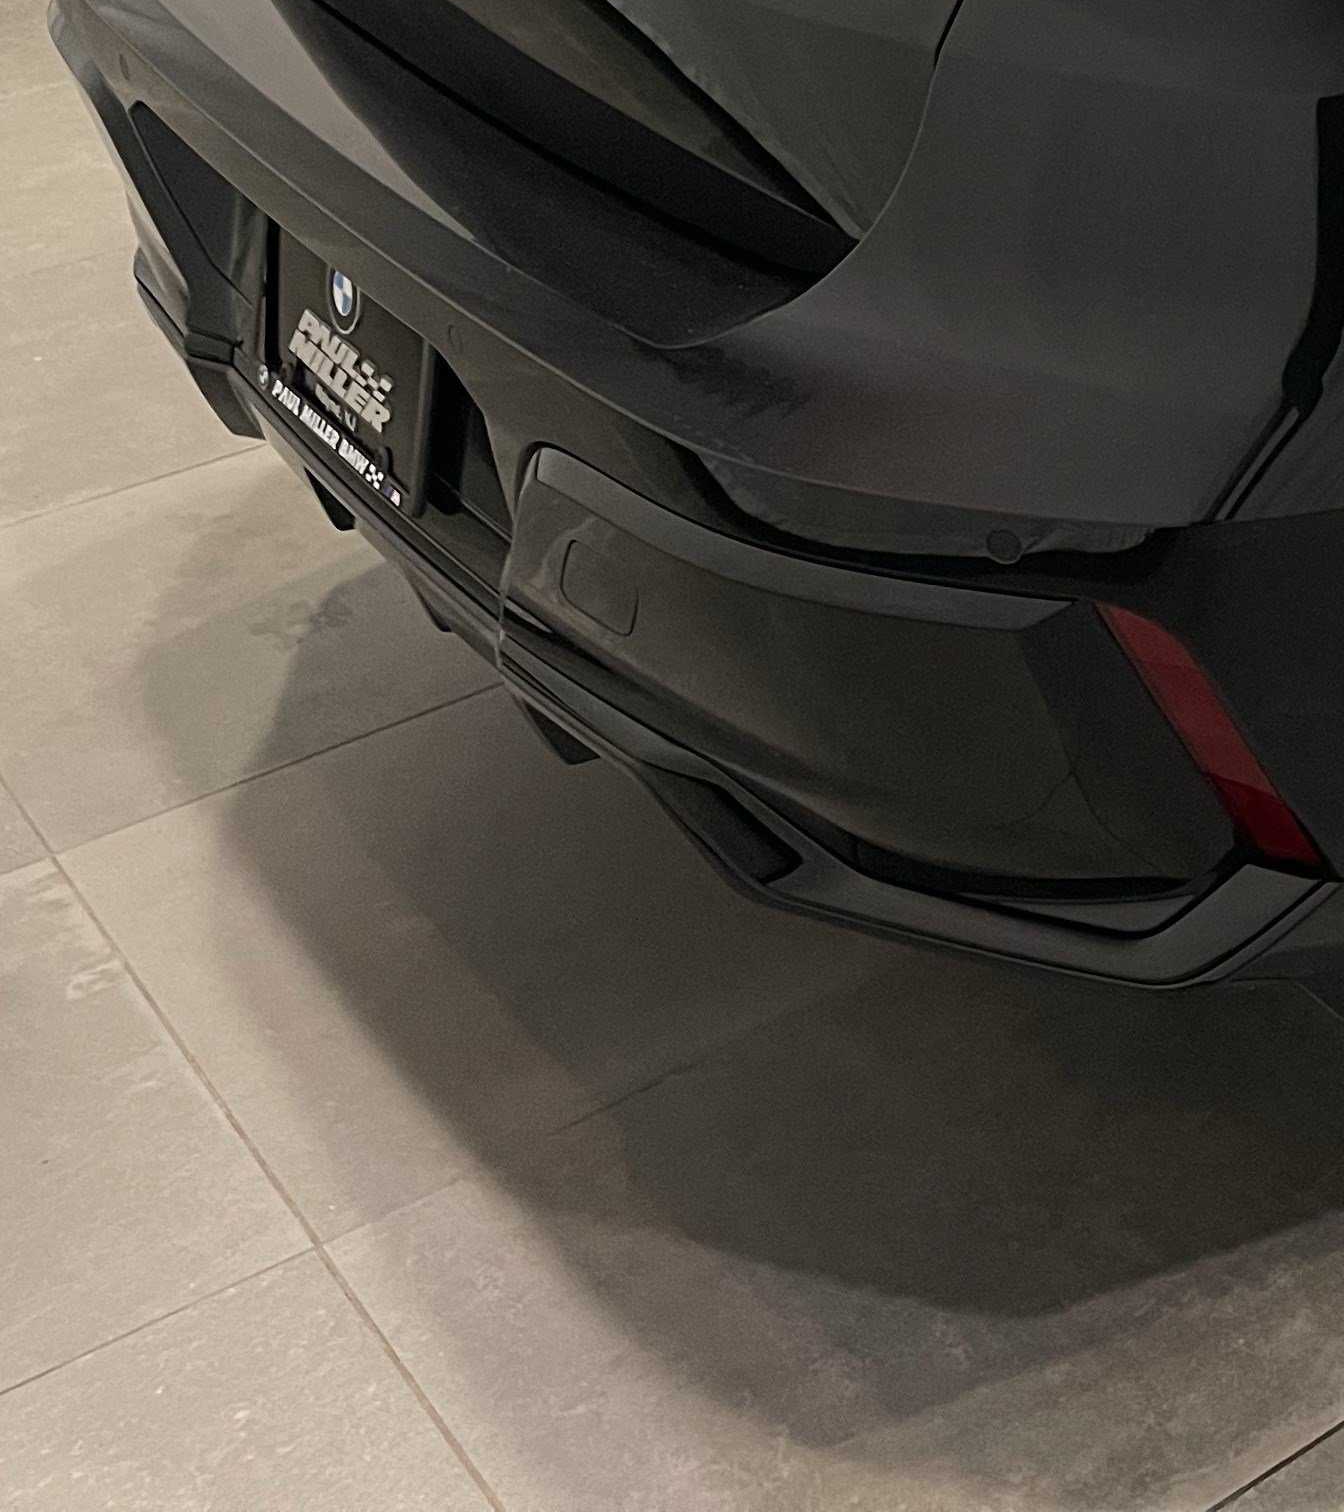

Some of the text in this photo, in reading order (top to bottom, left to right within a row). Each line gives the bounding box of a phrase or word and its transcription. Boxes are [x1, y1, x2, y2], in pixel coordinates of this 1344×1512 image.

[288, 329, 391, 433] MILLER
[298, 308, 367, 387] PAUL
[298, 403, 340, 451] MILLER
[338, 437, 370, 475] BMW
